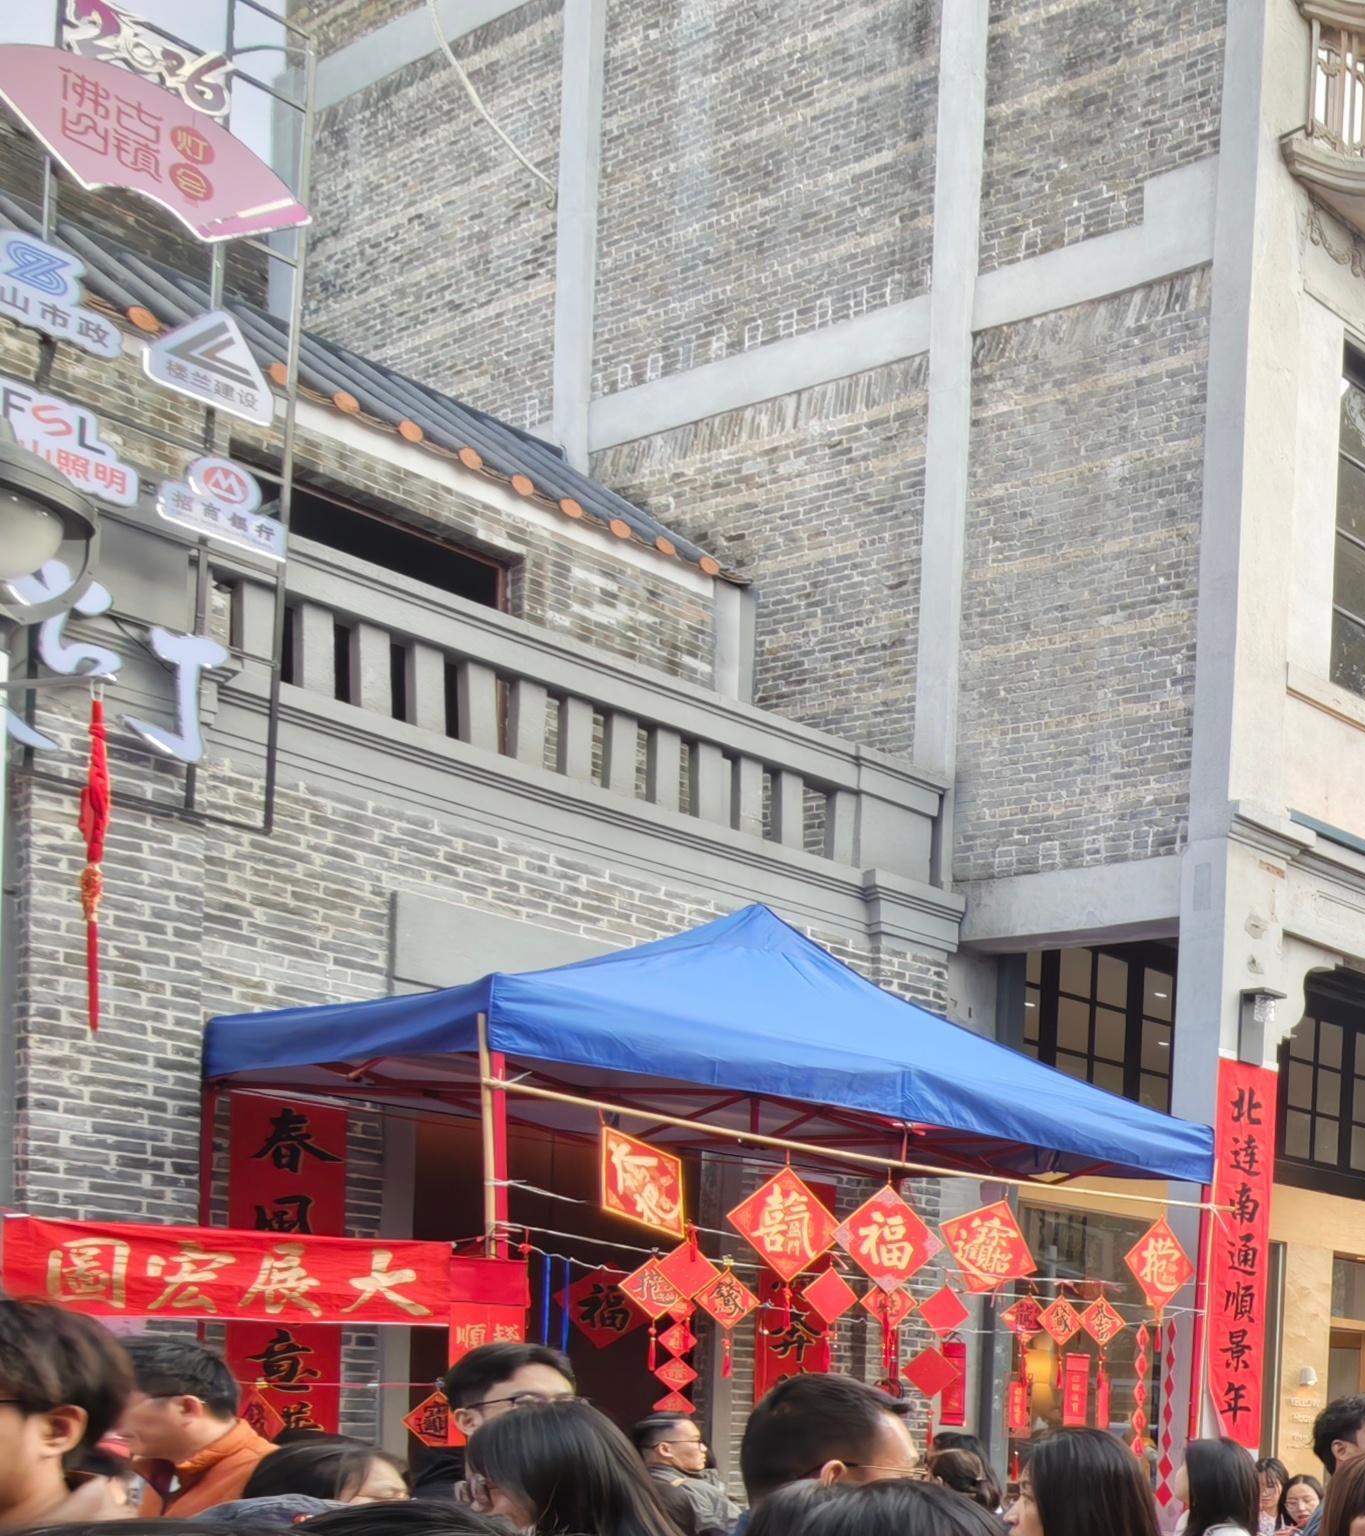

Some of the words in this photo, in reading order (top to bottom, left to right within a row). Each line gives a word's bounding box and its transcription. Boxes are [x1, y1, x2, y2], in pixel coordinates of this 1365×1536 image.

[2, 384, 106, 456] FSL
[859, 1210, 914, 1270] 福
[579, 1283, 630, 1333] 福
